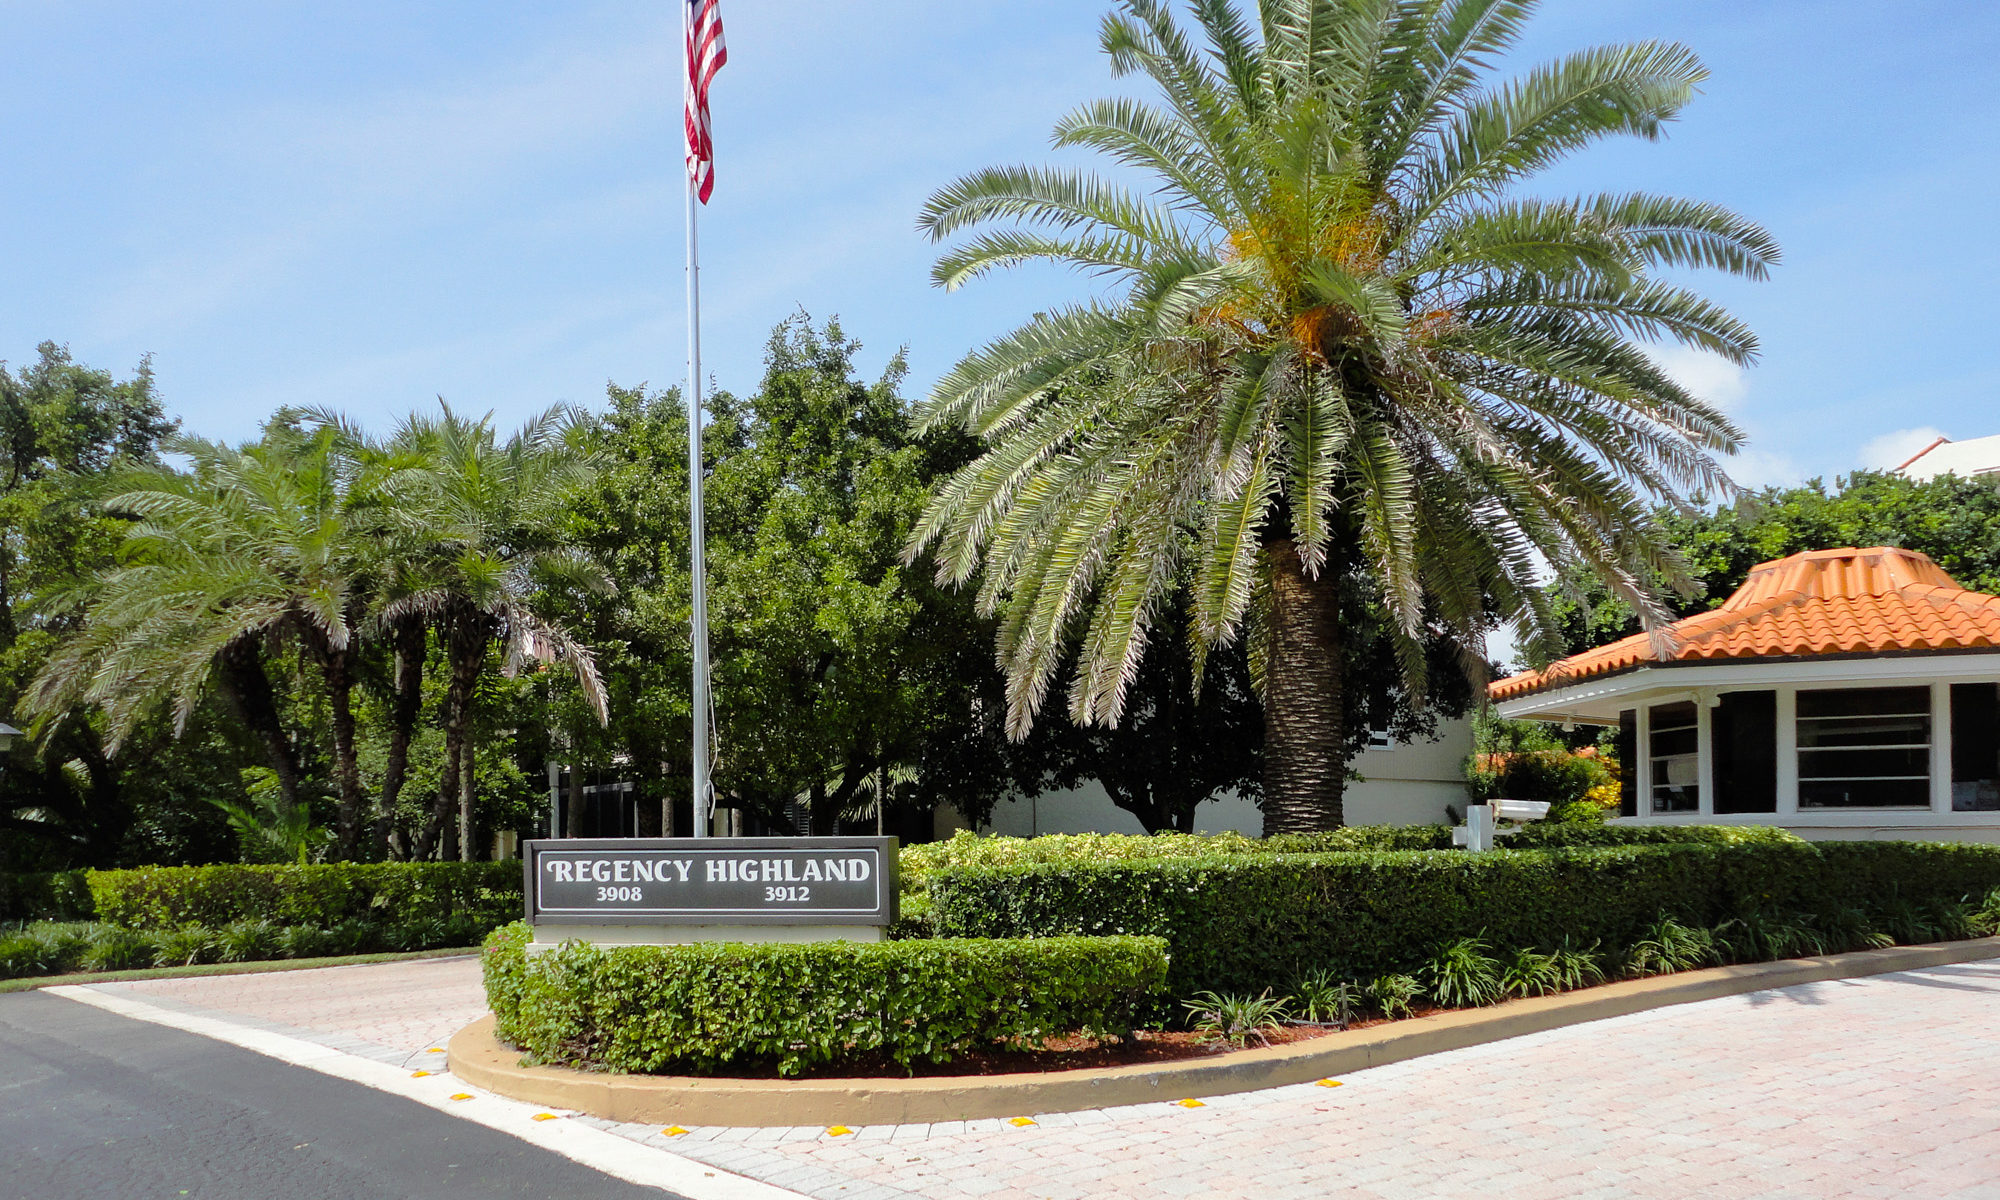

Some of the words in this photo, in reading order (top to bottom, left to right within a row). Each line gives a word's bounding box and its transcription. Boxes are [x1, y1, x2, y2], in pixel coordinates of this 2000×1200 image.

[546, 860, 693, 883] REGENCY
[705, 859, 871, 882] HIGHLAND
[596, 886, 643, 902] 3908
[764, 886, 811, 902] 3912
